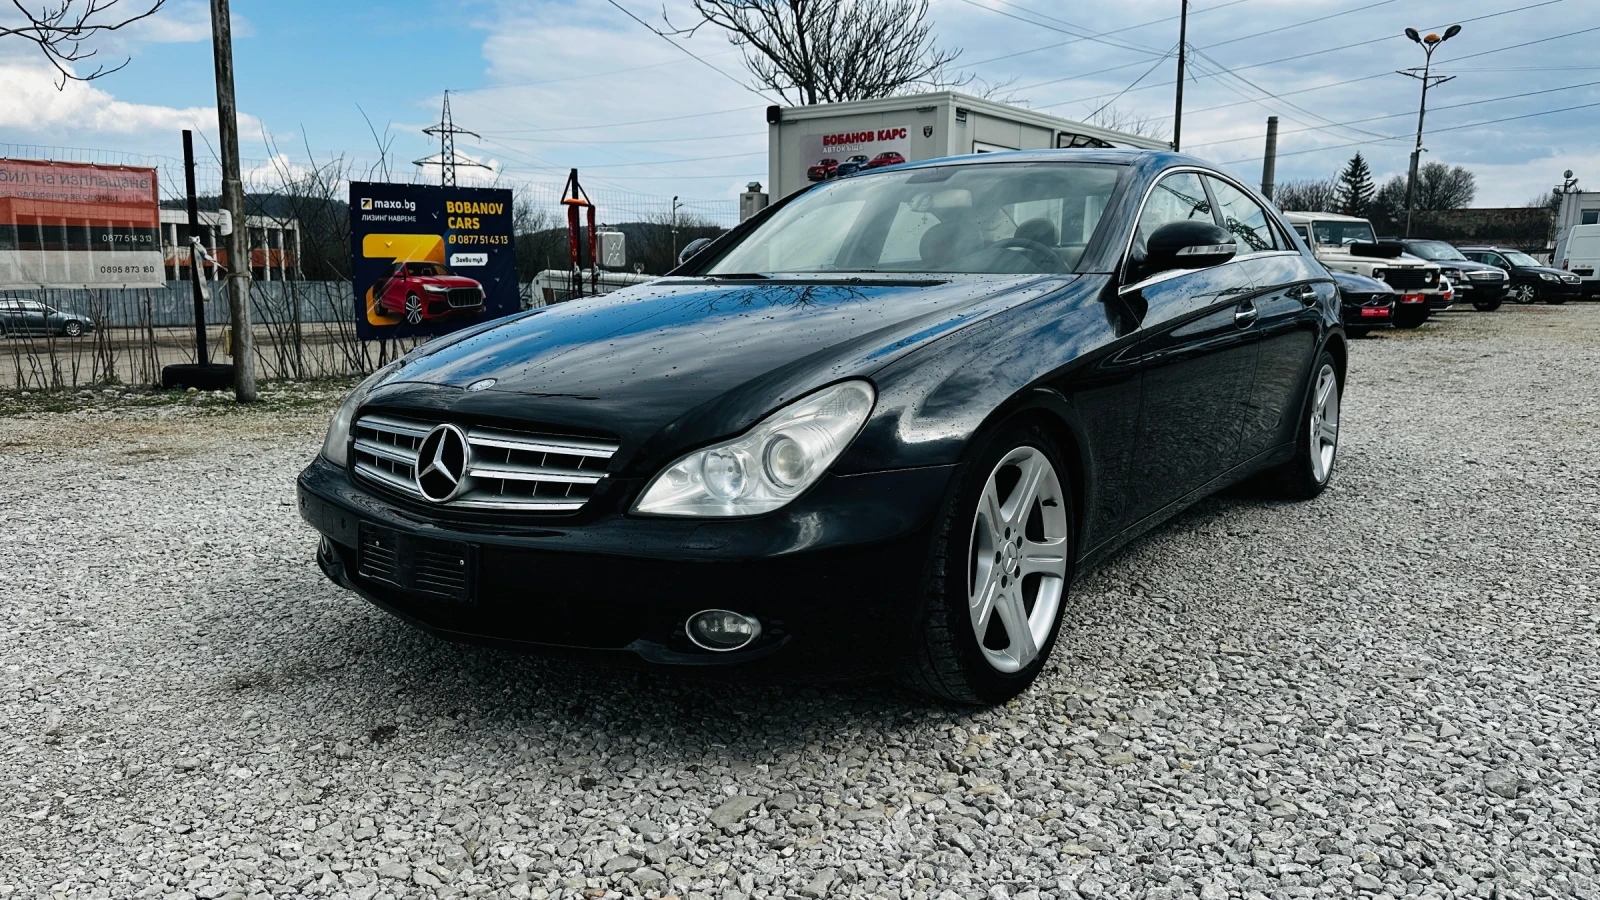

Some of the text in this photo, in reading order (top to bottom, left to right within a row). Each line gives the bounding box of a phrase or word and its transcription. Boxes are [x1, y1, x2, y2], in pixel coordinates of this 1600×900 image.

[823, 128, 907, 146] БОБАНОВ КАРС
[822, 144, 864, 154] АВТОКЪЩА
[34, 173, 55, 185] на
[60, 173, 149, 190] изплащане
[374, 199, 416, 212] maxo.bg
[446, 201, 504, 215] BOBANOV
[448, 216, 480, 229] CARS
[102, 234, 152, 242] 0877 514 313
[457, 235, 508, 244] 0877 51 43 13
[100, 265, 123, 274] 0895
[125, 265, 140, 274] 873
